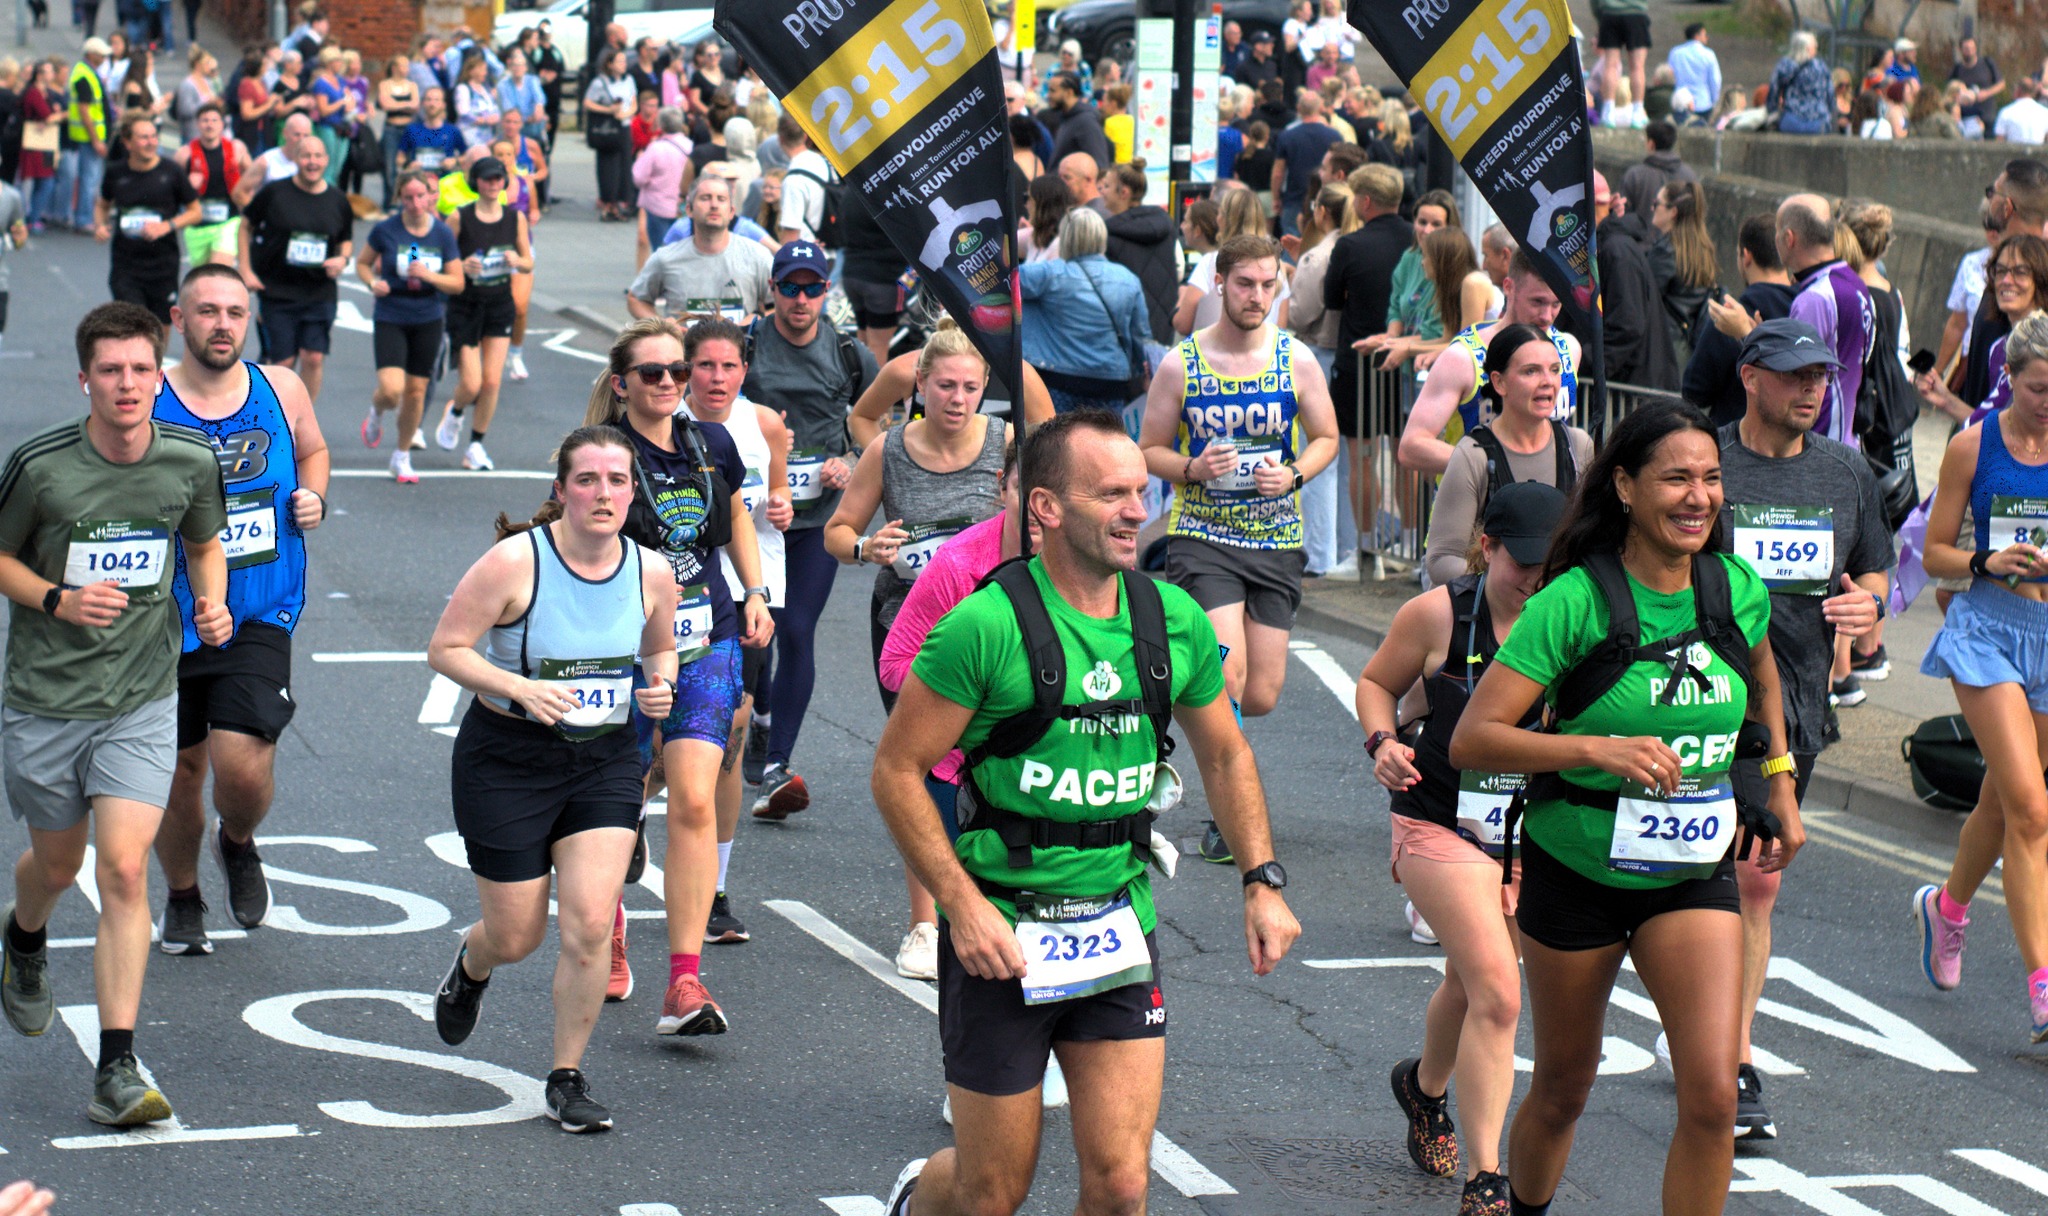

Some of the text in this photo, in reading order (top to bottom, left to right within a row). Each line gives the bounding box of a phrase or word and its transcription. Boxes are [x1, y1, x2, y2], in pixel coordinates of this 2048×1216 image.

[782, 0, 856, 49] PRO
[810, 0, 966, 155] 2:15
[1425, 0, 1551, 142] 2:15
[862, 86, 985, 195] #FEEDYOURDRIVE
[1474, 73, 1573, 179] #FEEDYOURDRIVE
[1512, 115, 1563, 165] Jane Tomlinson's
[910, 129, 970, 181] Jane Tomlinson's
[919, 126, 1003, 197] RUN FOR ALL
[1520, 152, 1549, 181] RUN
[1545, 129, 1572, 157] FOR
[1559, 218, 1574, 234] Arla
[957, 237, 1001, 278] PROTEIN
[961, 235, 979, 252] Arla
[967, 261, 999, 289] MANGO
[976, 276, 1000, 295] YOGURT
[1187, 402, 1284, 438] RSPCA
[788, 473, 810, 487] 32
[89, 551, 150, 572] 1042
[226, 546, 245, 554] JACK
[1755, 541, 1819, 562] 1569
[1775, 568, 1793, 576] JEFF
[1485, 807, 1509, 827] 4
[1638, 815, 1719, 842] 2360
[1063, 901, 1093, 912] IPSWICH
[1040, 928, 1122, 961] 2323
